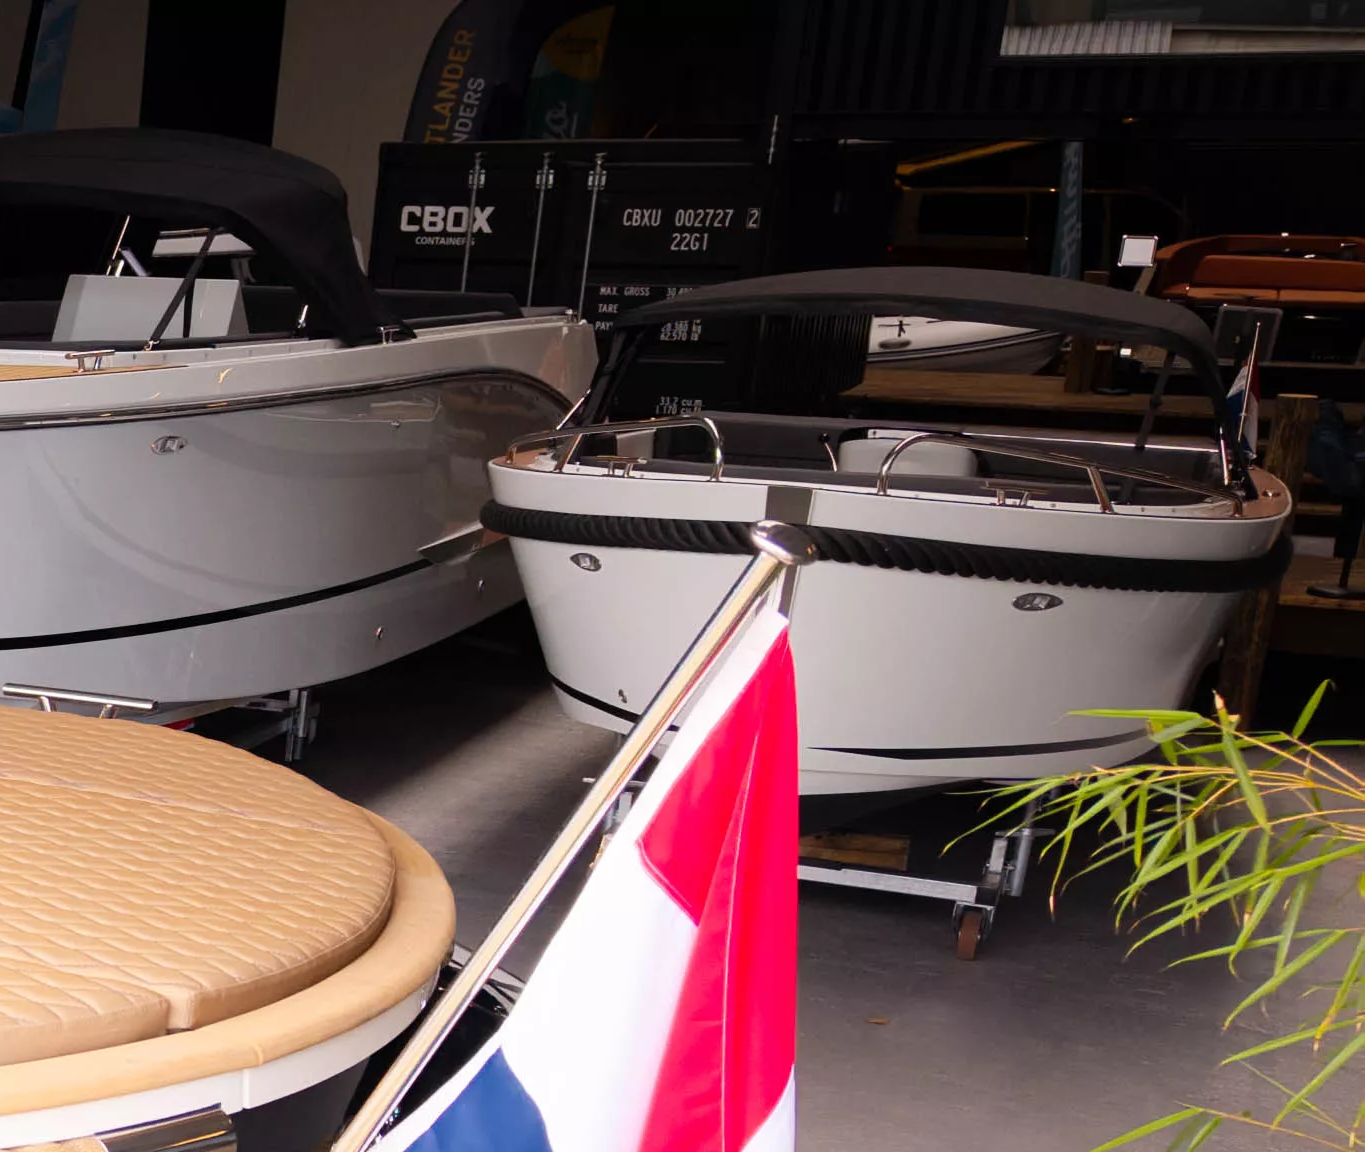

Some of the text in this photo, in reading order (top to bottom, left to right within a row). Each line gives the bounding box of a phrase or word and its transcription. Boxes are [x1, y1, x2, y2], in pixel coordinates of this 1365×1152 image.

[399, 205, 496, 233] CBOX
[623, 207, 761, 224] CBXU 002727 2
[670, 232, 709, 251] 22G1
[624, 286, 650, 297] GROSS
[597, 304, 619, 314] TARE
